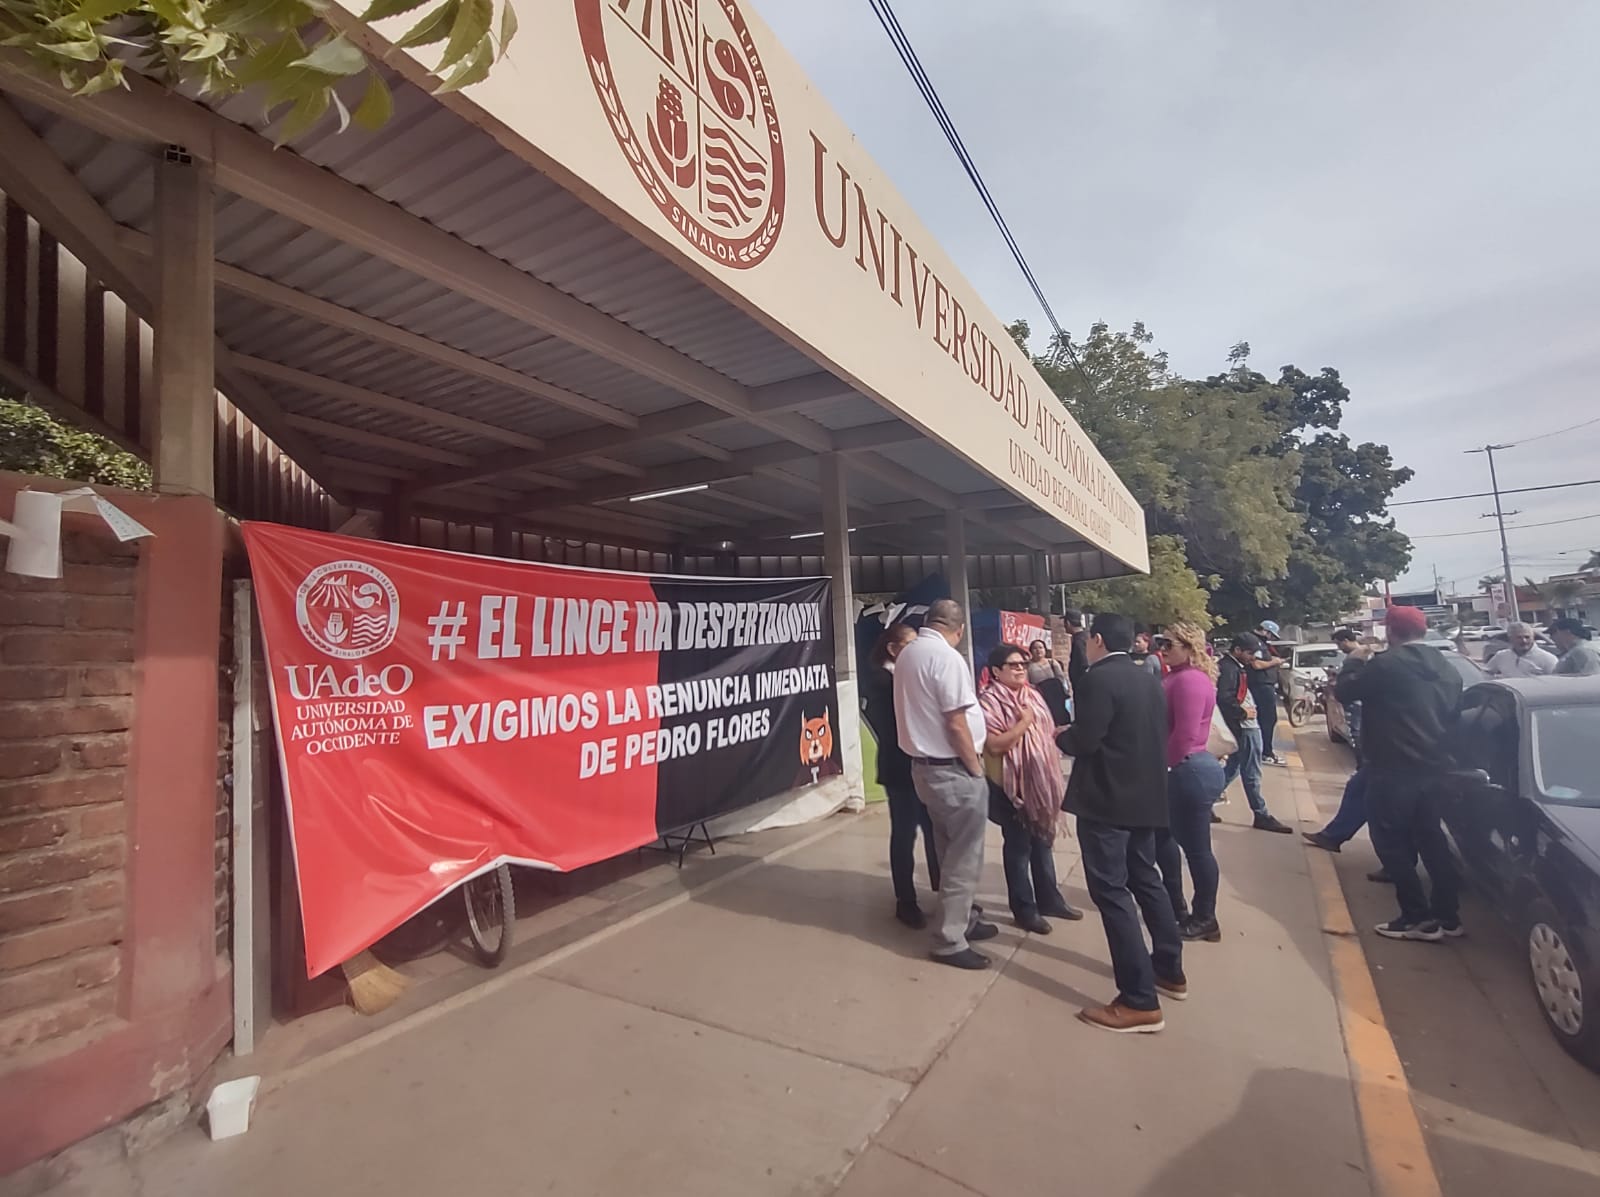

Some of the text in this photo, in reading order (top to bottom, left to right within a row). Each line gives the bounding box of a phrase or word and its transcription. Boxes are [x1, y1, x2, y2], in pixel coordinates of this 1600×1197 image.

[740, 29, 780, 144] LIBERTAD
[671, 206, 737, 262] SINALOA
[809, 129, 1029, 430] UNIVERSIDAD
[1033, 398, 1096, 498] AUTÓNOMA
[1009, 438, 1051, 498] UNIDAD
[477, 595, 522, 659] EL
[531, 596, 629, 657] LINCE
[634, 601, 673, 652] HA
[284, 664, 414, 700] UAdeO
[296, 699, 406, 721] UNIVERSIDAD
[423, 663, 830, 750] EXIGIMOS LA RENUNCIA INMEDIATA
[290, 714, 414, 741] AUTÓNOMA DE
[306, 731, 401, 756] OCCIDENTE
[579, 707, 771, 780] DE PEDRO FLORES
